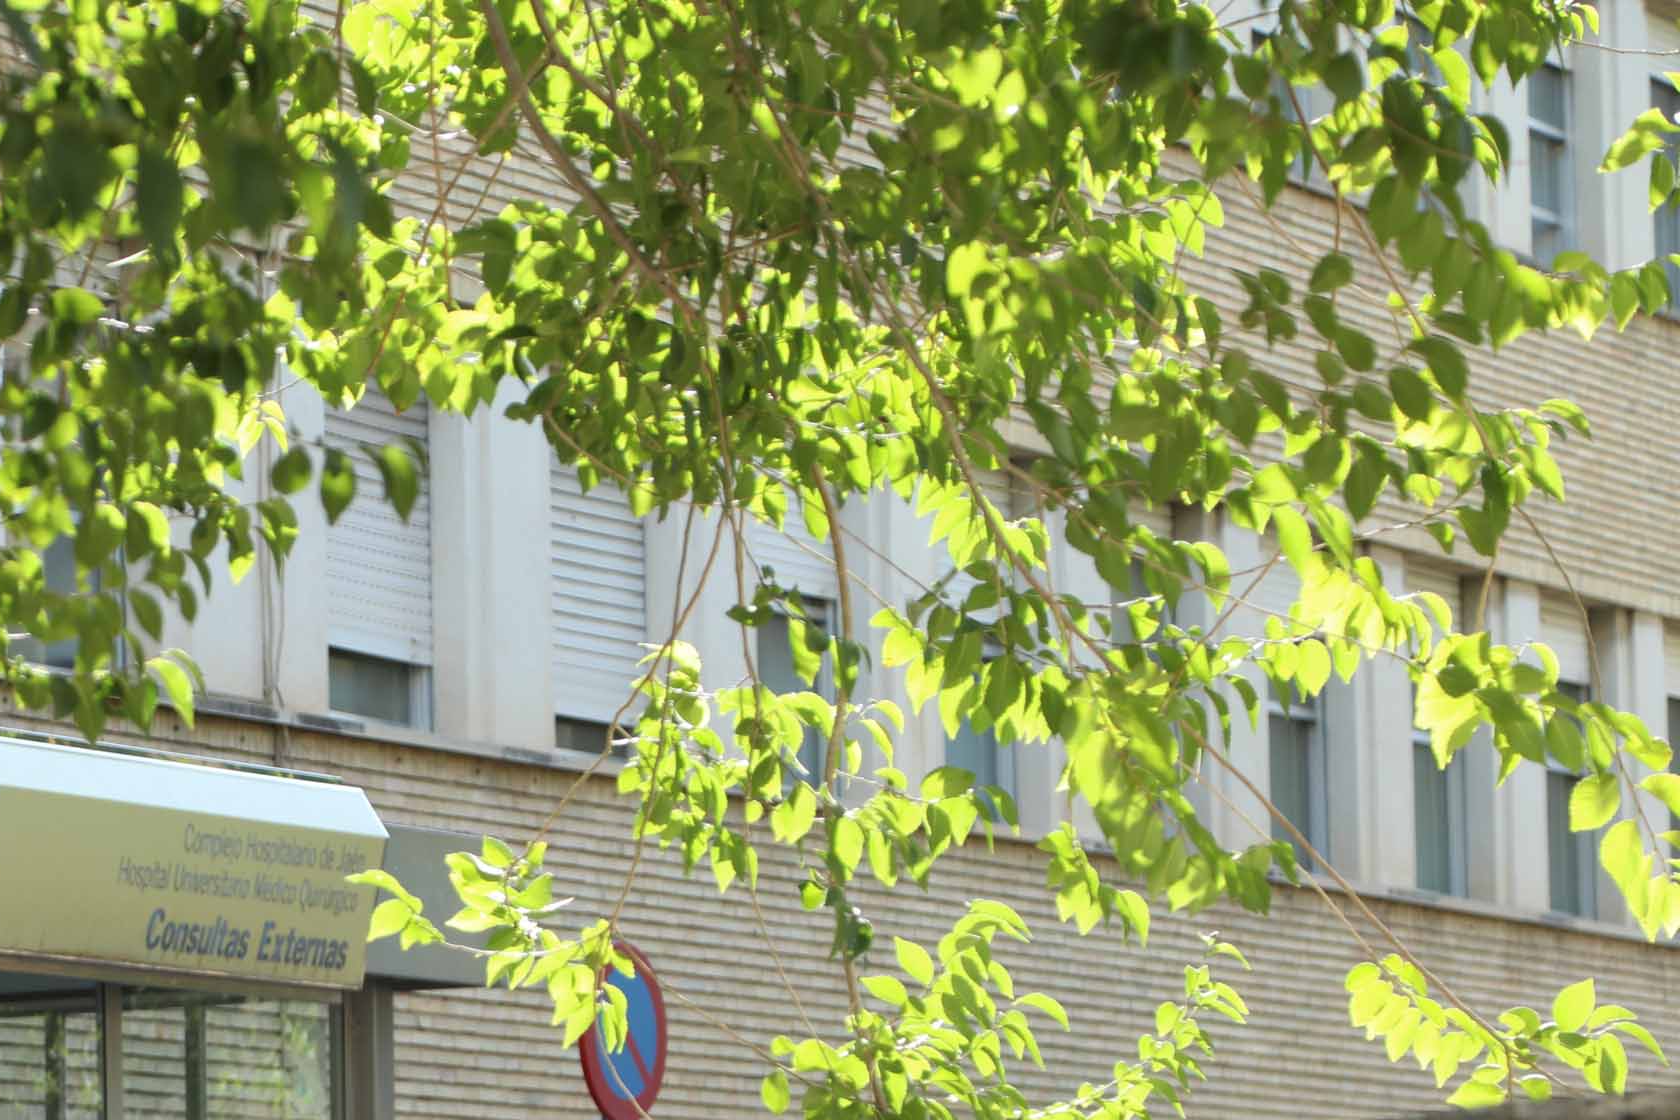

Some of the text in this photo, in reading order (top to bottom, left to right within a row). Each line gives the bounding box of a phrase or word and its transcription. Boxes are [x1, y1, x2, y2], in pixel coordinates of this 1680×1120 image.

[320, 842, 334, 868] de
[118, 856, 169, 892] Hospital
[145, 907, 349, 970] Consultas Externas
